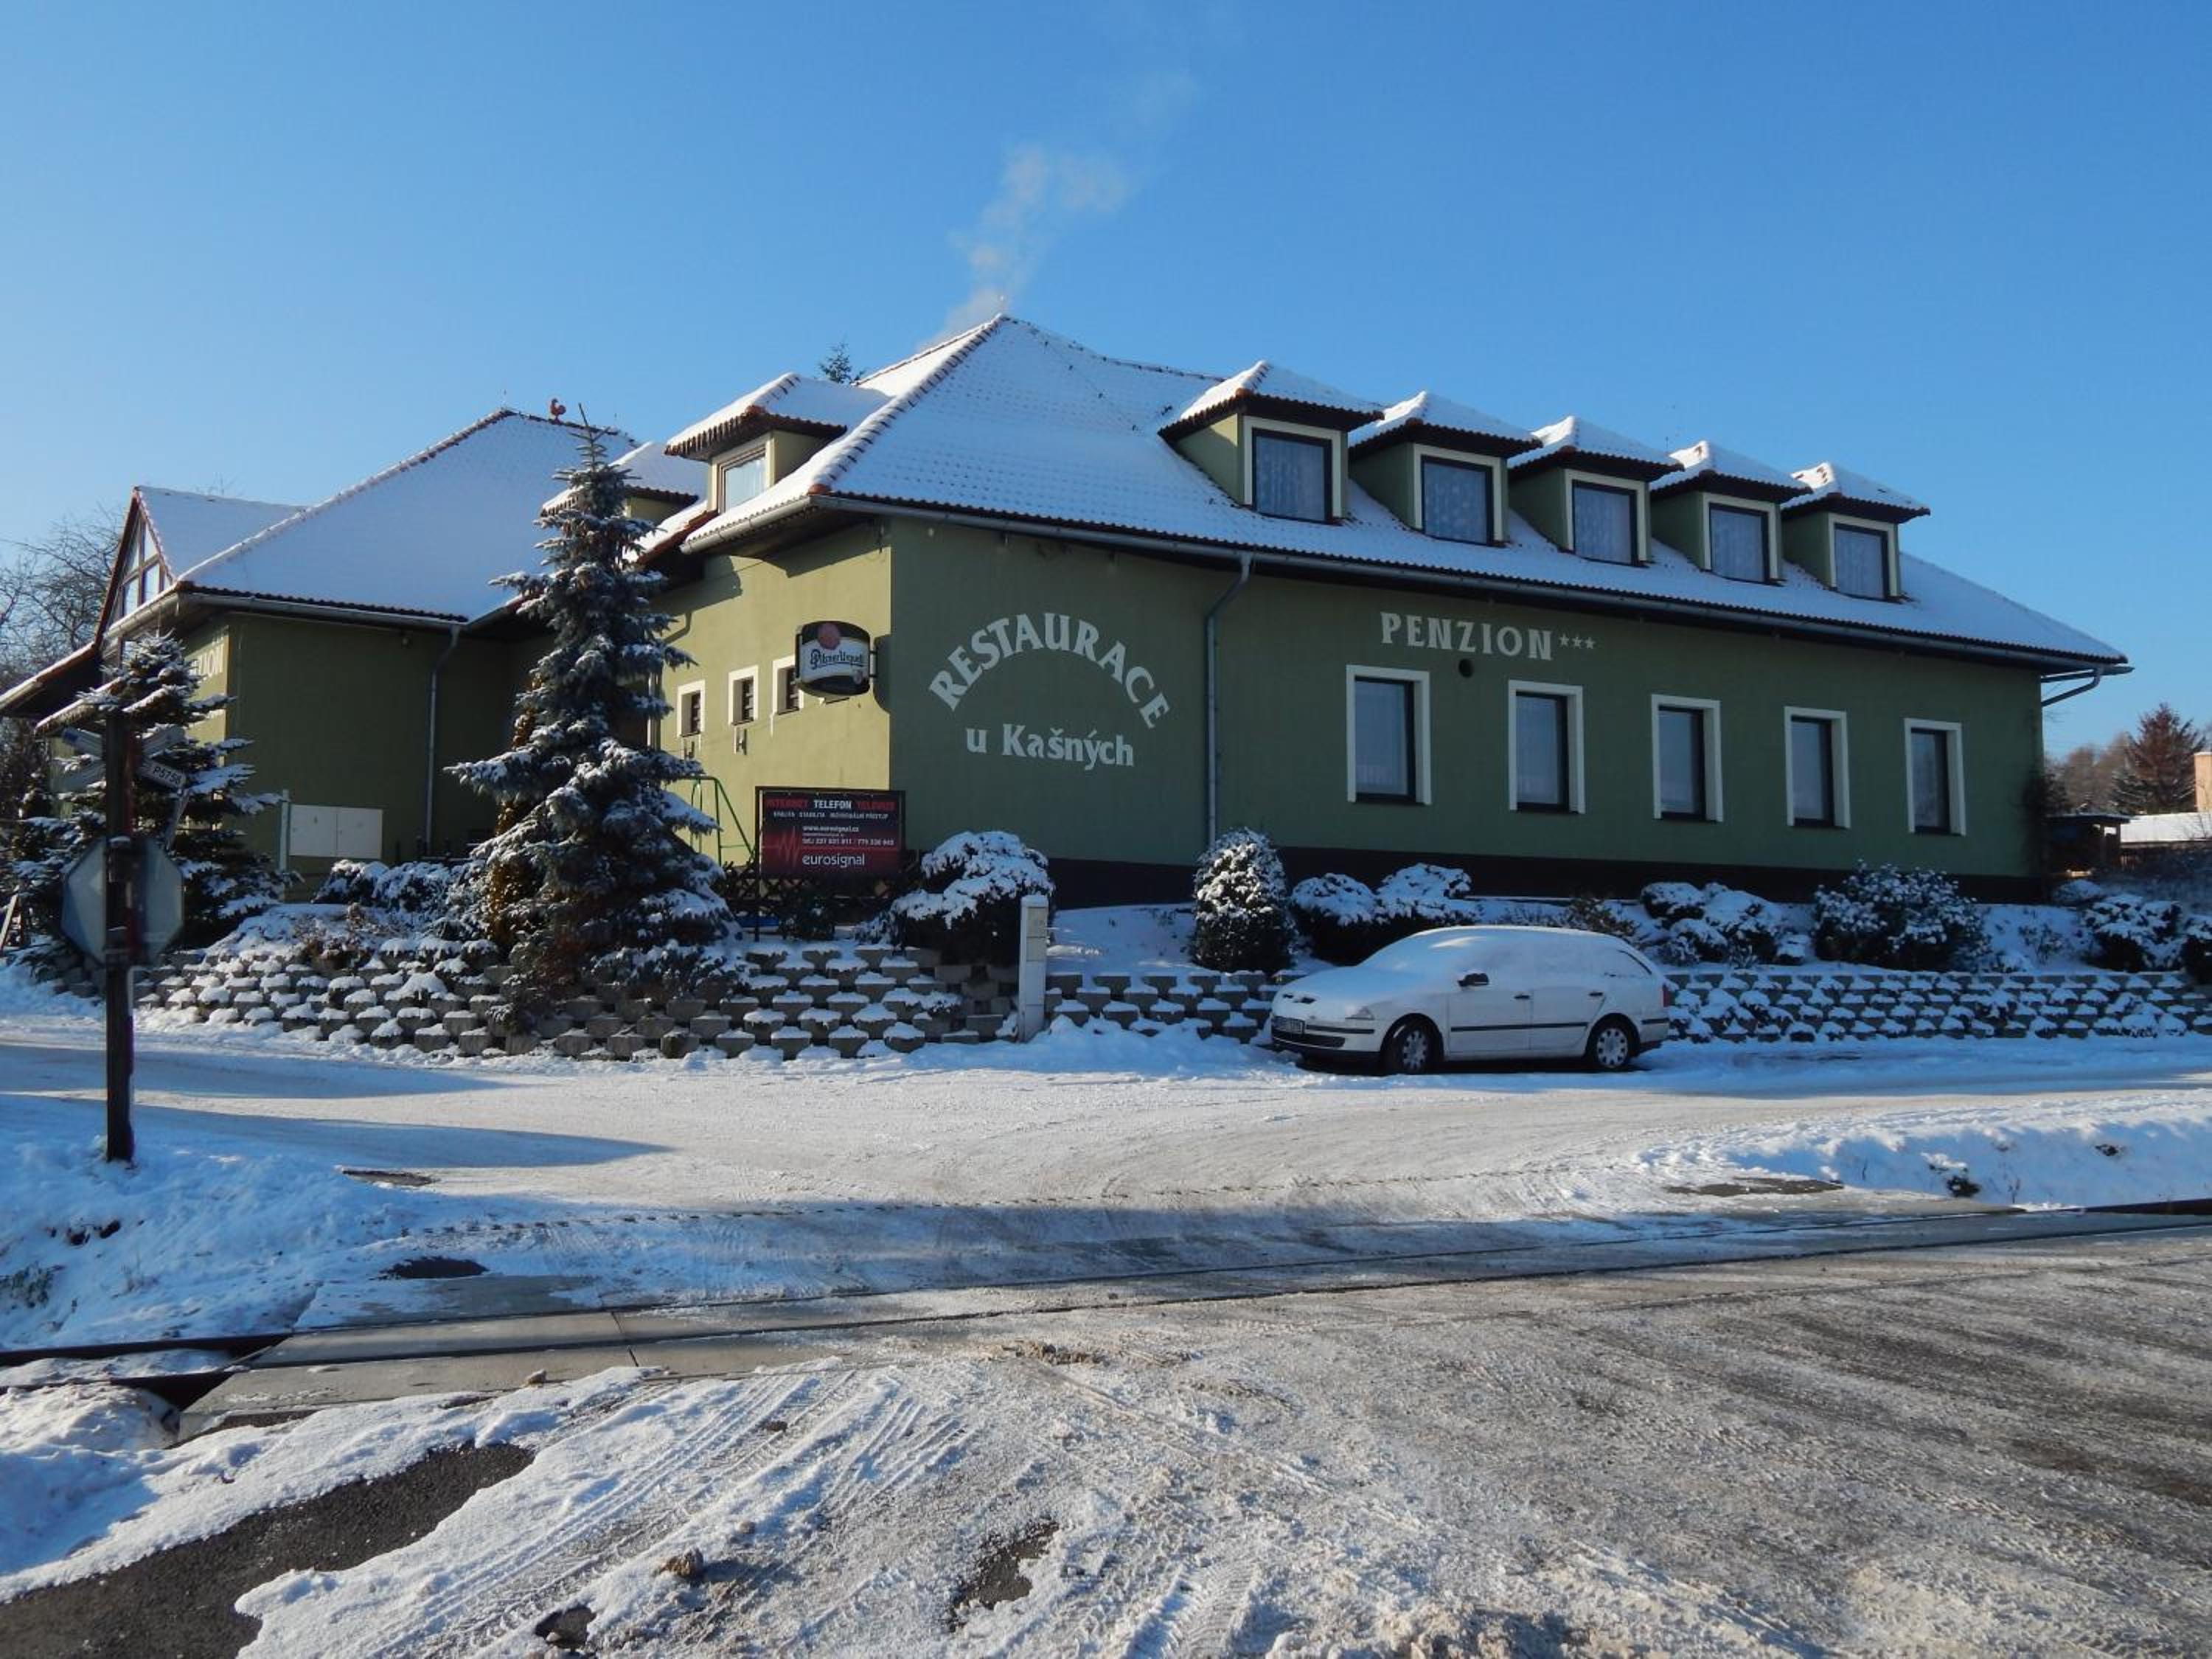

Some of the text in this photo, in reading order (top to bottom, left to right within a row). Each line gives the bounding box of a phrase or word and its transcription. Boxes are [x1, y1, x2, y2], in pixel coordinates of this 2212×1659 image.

[1380, 611, 1552, 661] PENZION
[929, 613, 1170, 728] RESTAURACE
[966, 723, 1134, 770] u Kašných
[813, 799, 852, 810] TELEFON
[802, 853, 865, 868] eurosignal
